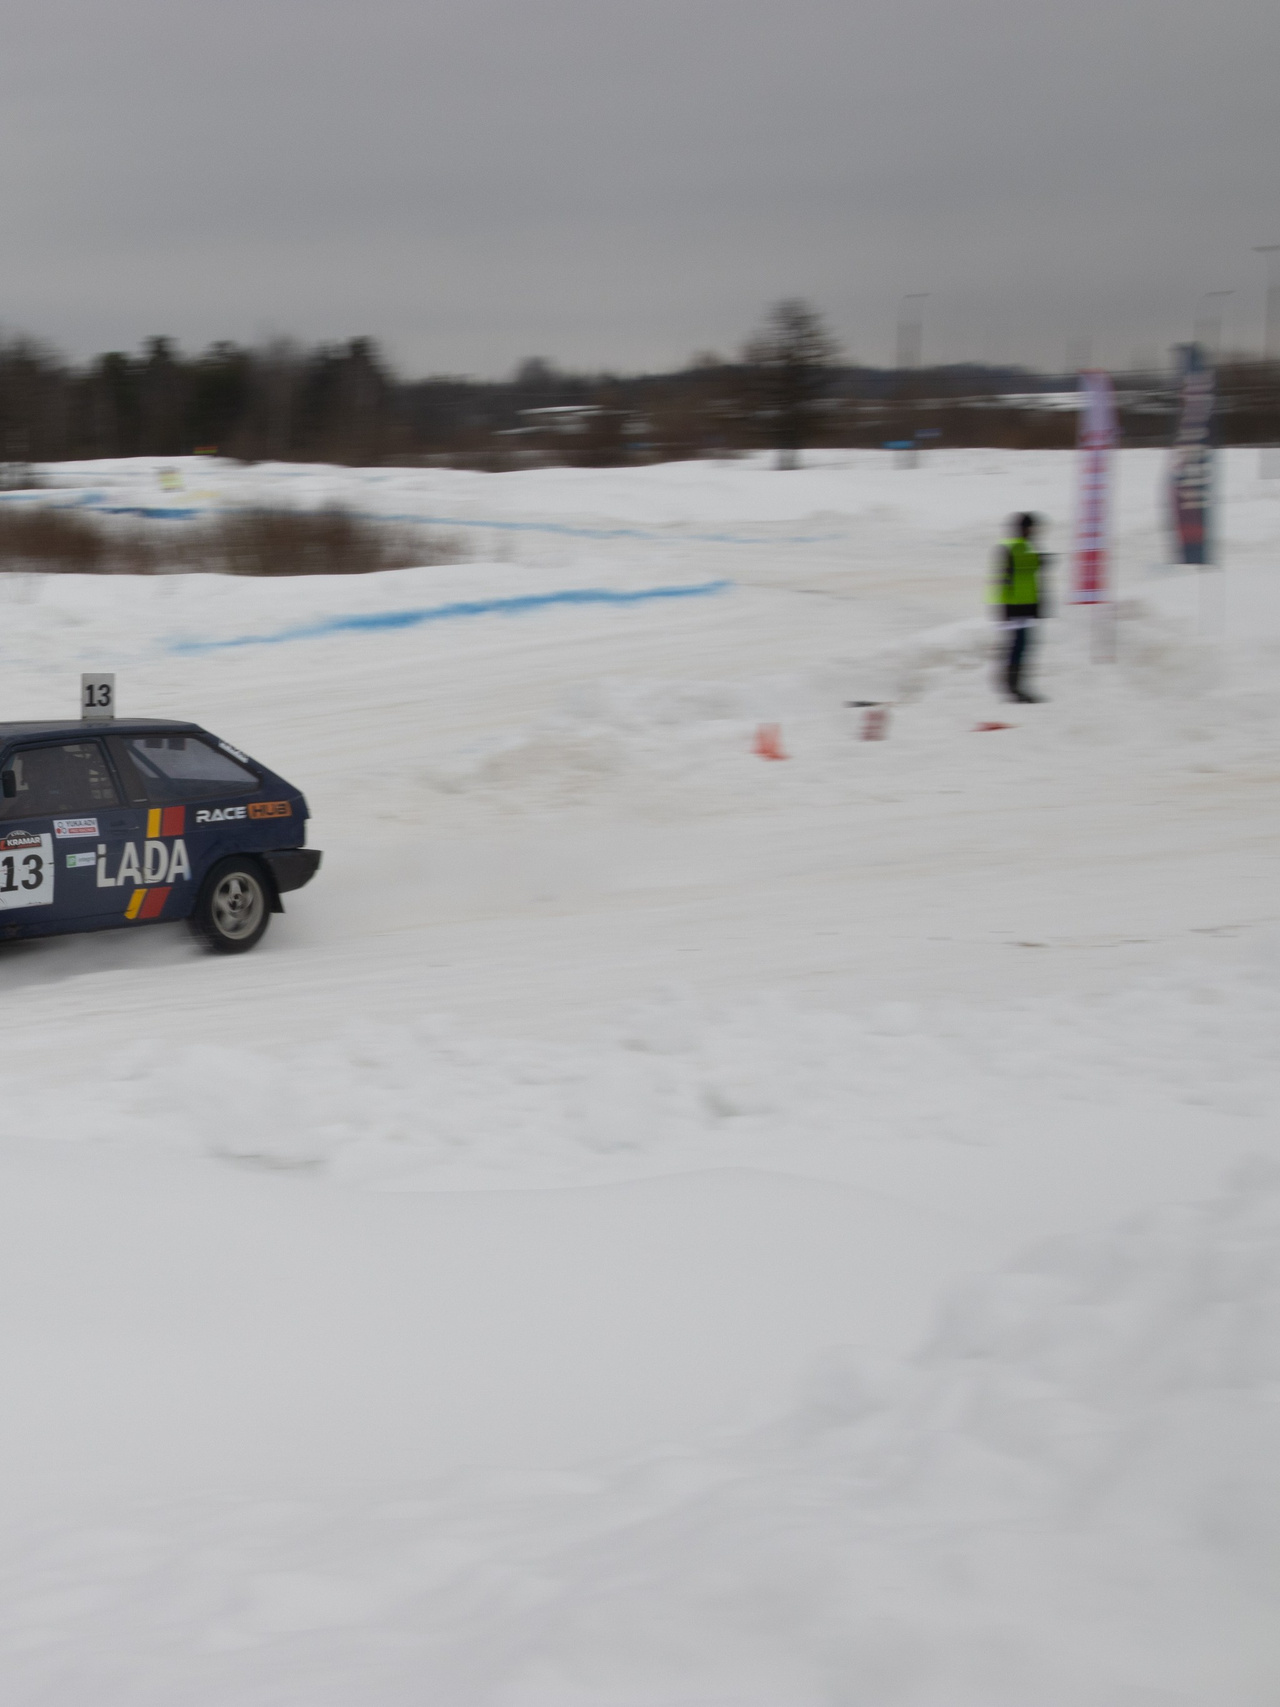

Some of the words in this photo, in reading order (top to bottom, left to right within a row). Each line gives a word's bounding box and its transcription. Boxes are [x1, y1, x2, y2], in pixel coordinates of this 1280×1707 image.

[85, 684, 111, 707] 13
[196, 806, 247, 823] RACE
[251, 803, 289, 817] HUB
[7, 836, 41, 847] KRAMAR
[0, 854, 43, 893] 13
[96, 839, 192, 888] LADA
